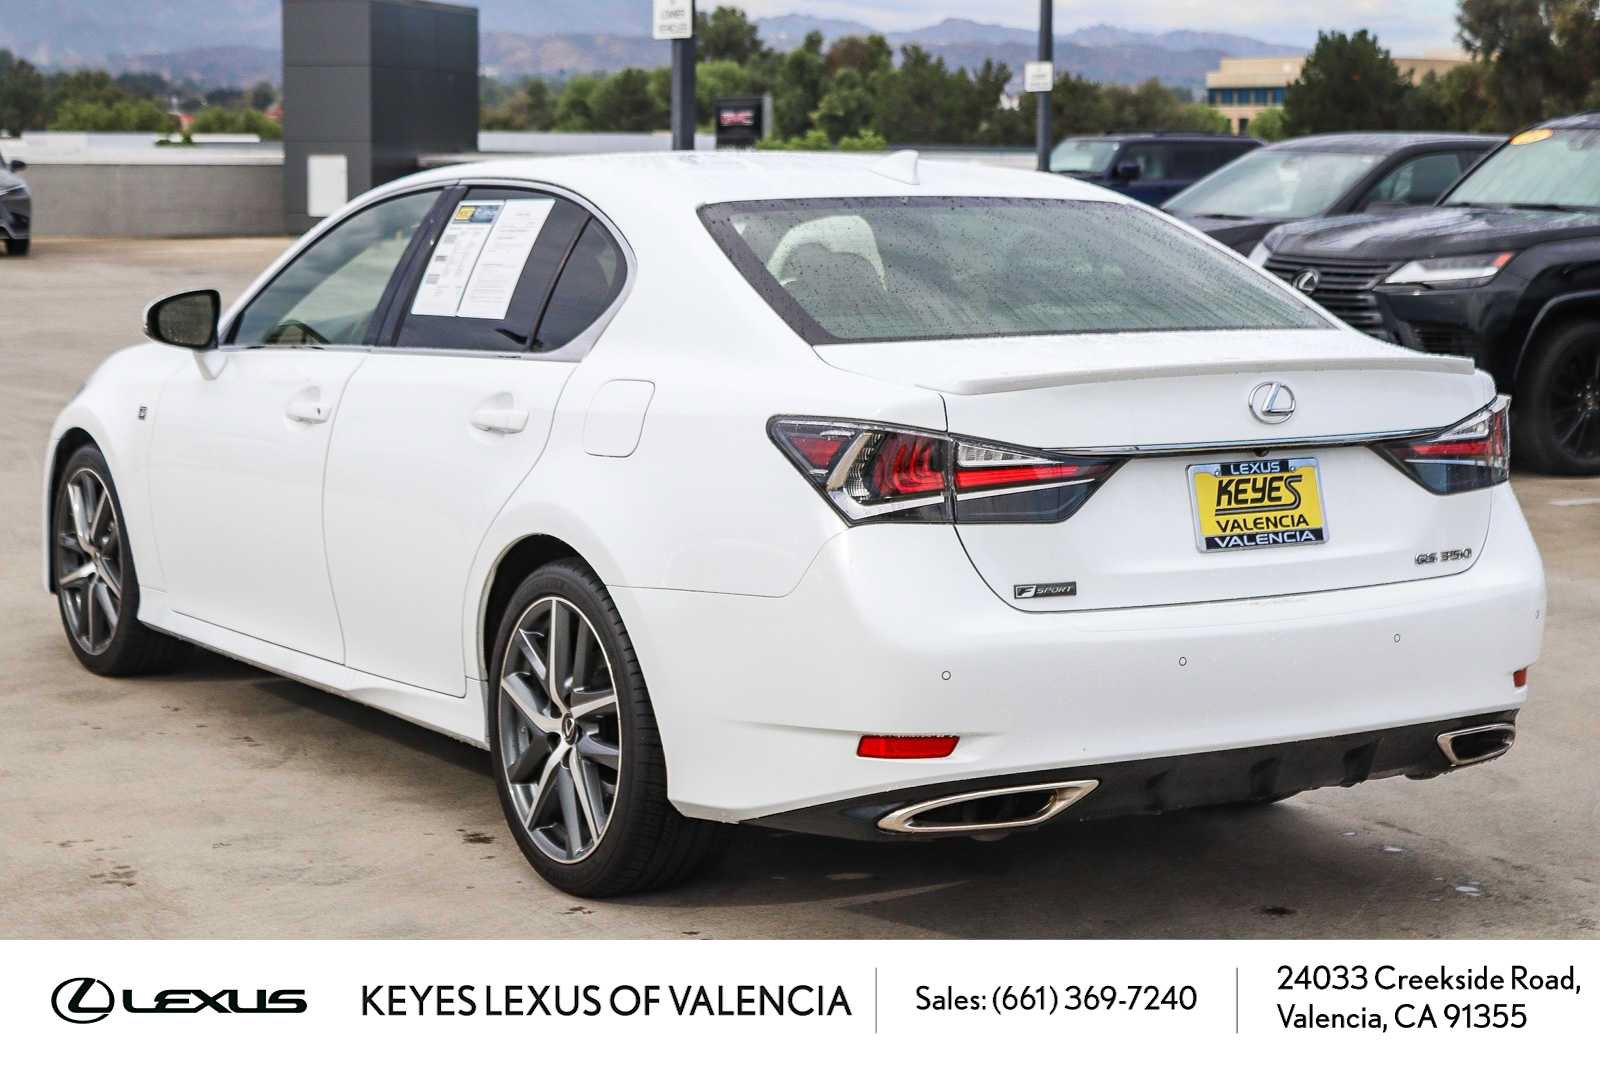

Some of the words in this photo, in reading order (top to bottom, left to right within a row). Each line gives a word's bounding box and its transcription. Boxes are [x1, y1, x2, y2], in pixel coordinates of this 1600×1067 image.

[1230, 461, 1281, 475] LEXUS
[1215, 475, 1303, 516] KEYES
[1216, 514, 1309, 533] VALENCIA
[1214, 530, 1316, 548] VALENCIA
[1440, 548, 1472, 561] 350
[1037, 585, 1073, 594] SPORT
